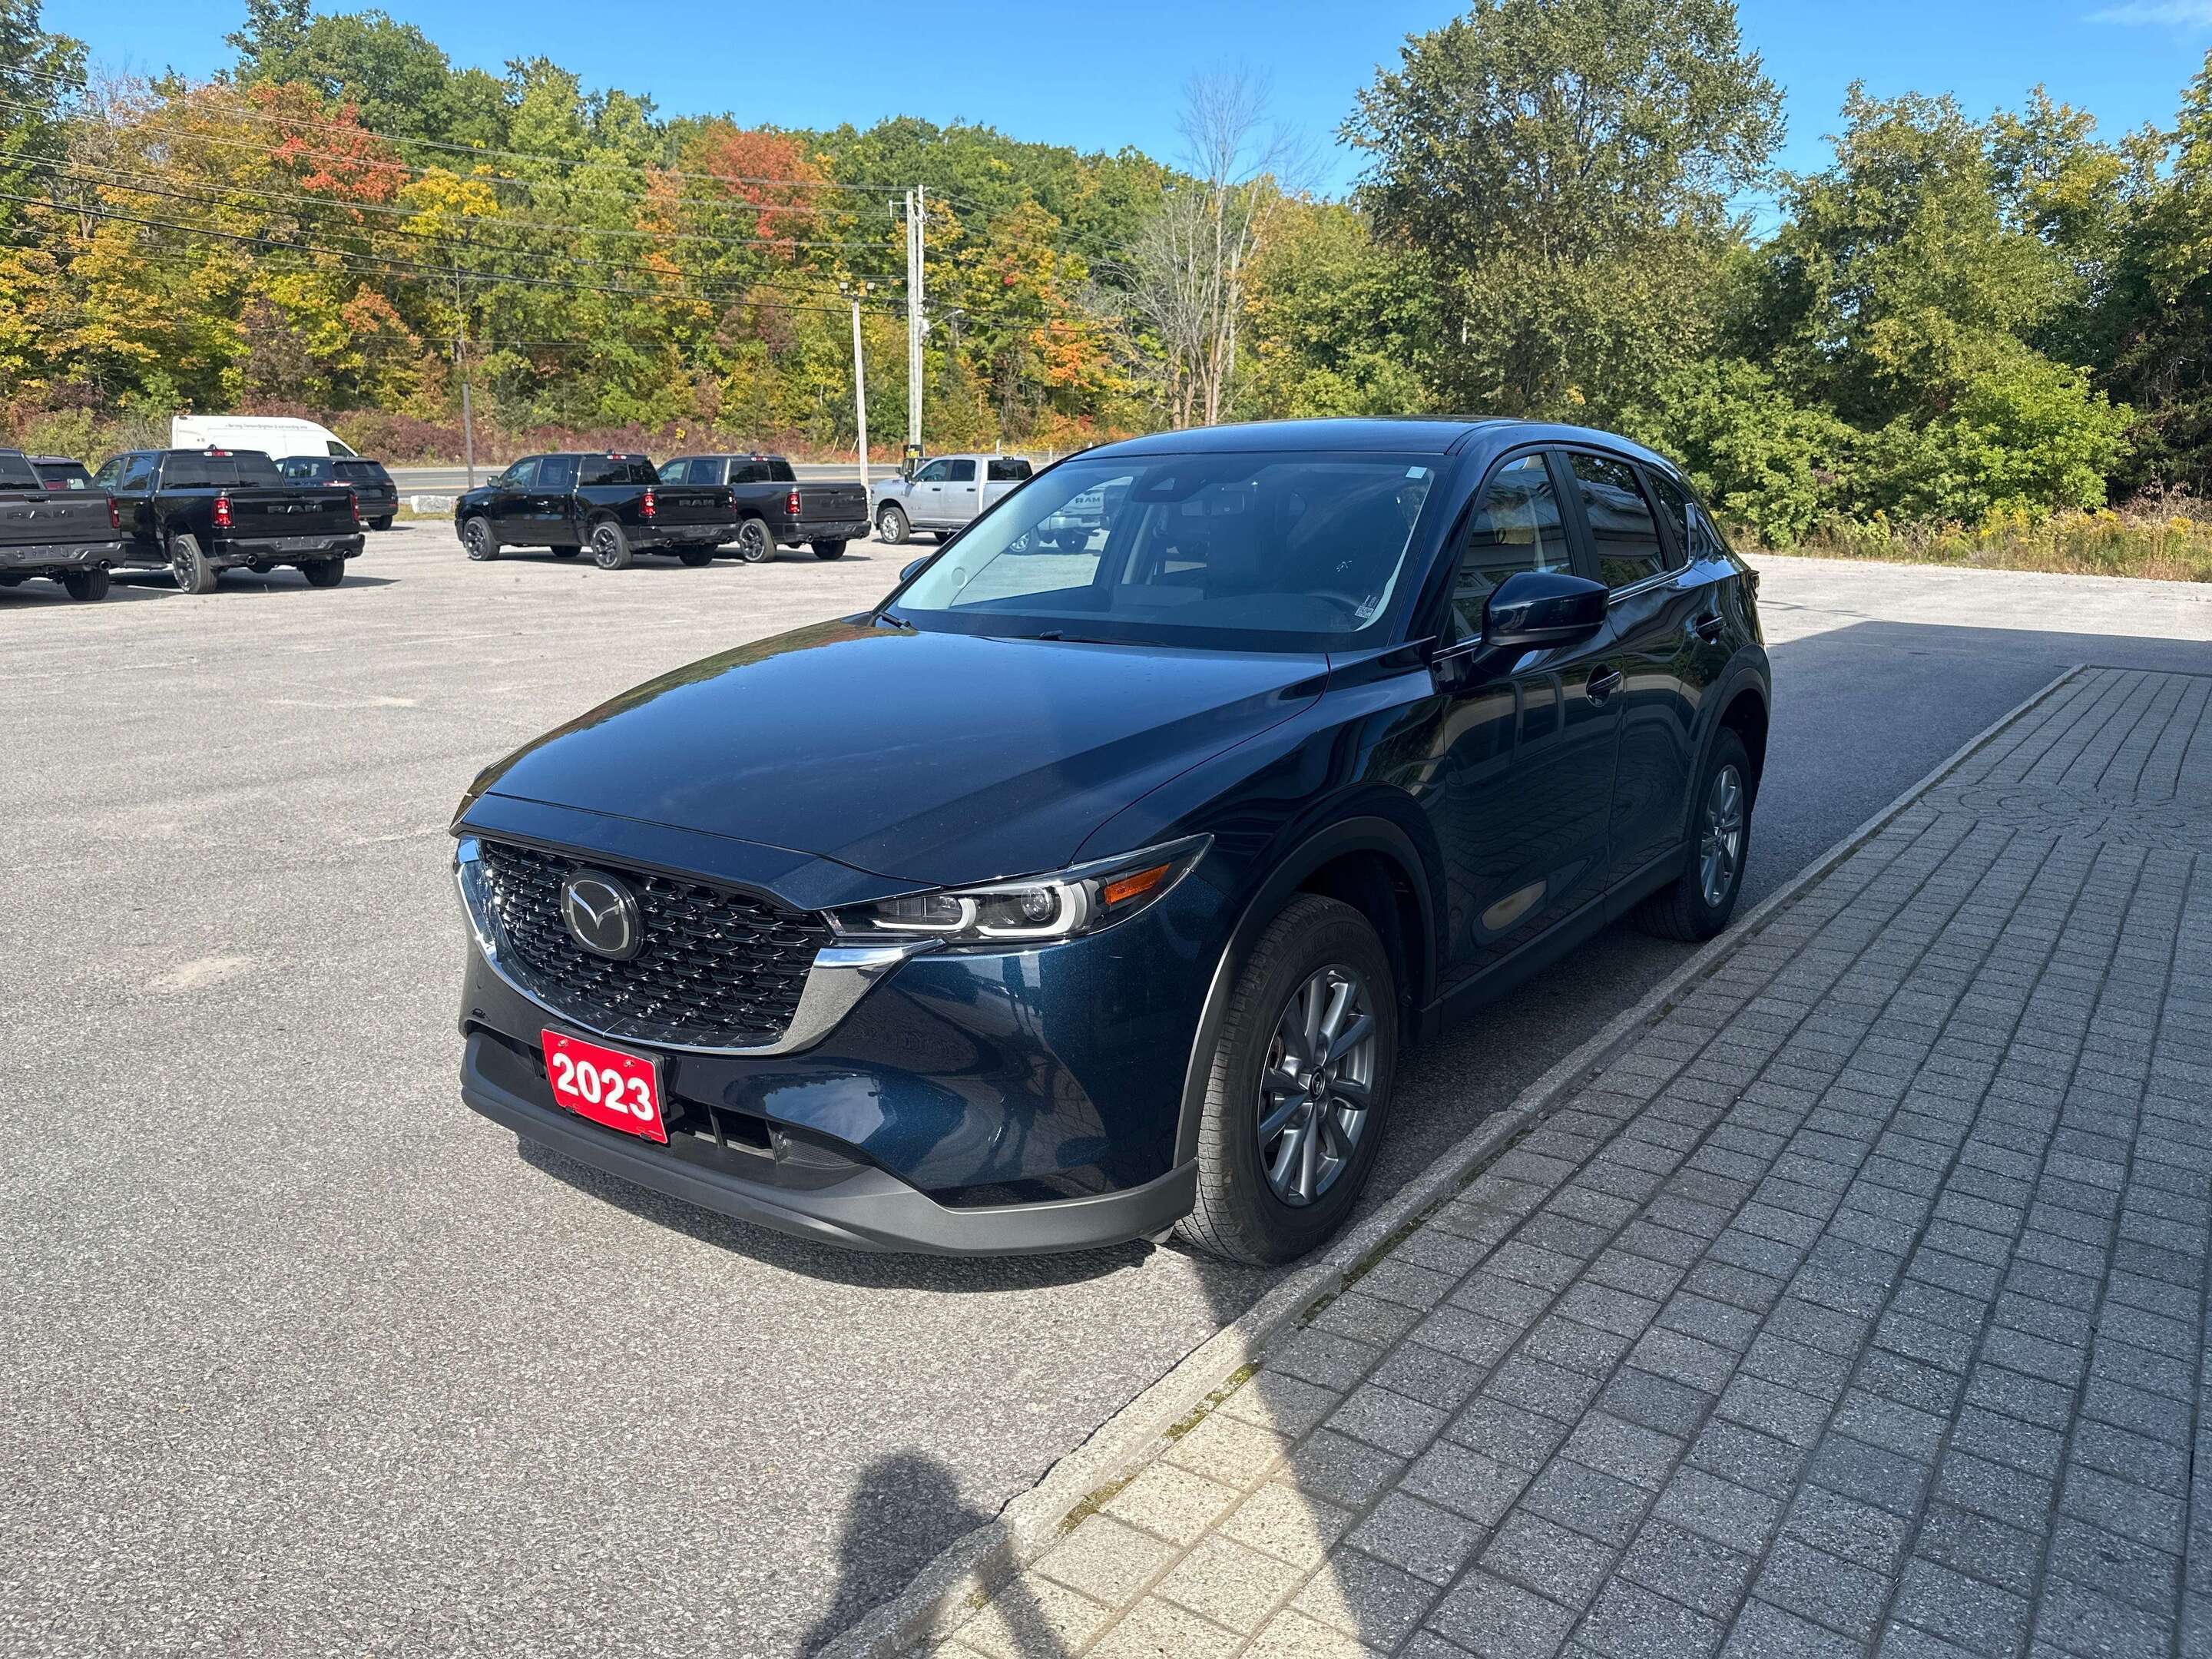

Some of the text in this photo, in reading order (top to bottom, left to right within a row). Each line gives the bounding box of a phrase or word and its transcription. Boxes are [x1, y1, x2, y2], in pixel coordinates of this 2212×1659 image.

[678, 498, 716, 507] RAM
[1075, 496, 1101, 505] RAM
[552, 1051, 654, 1121] 2023
